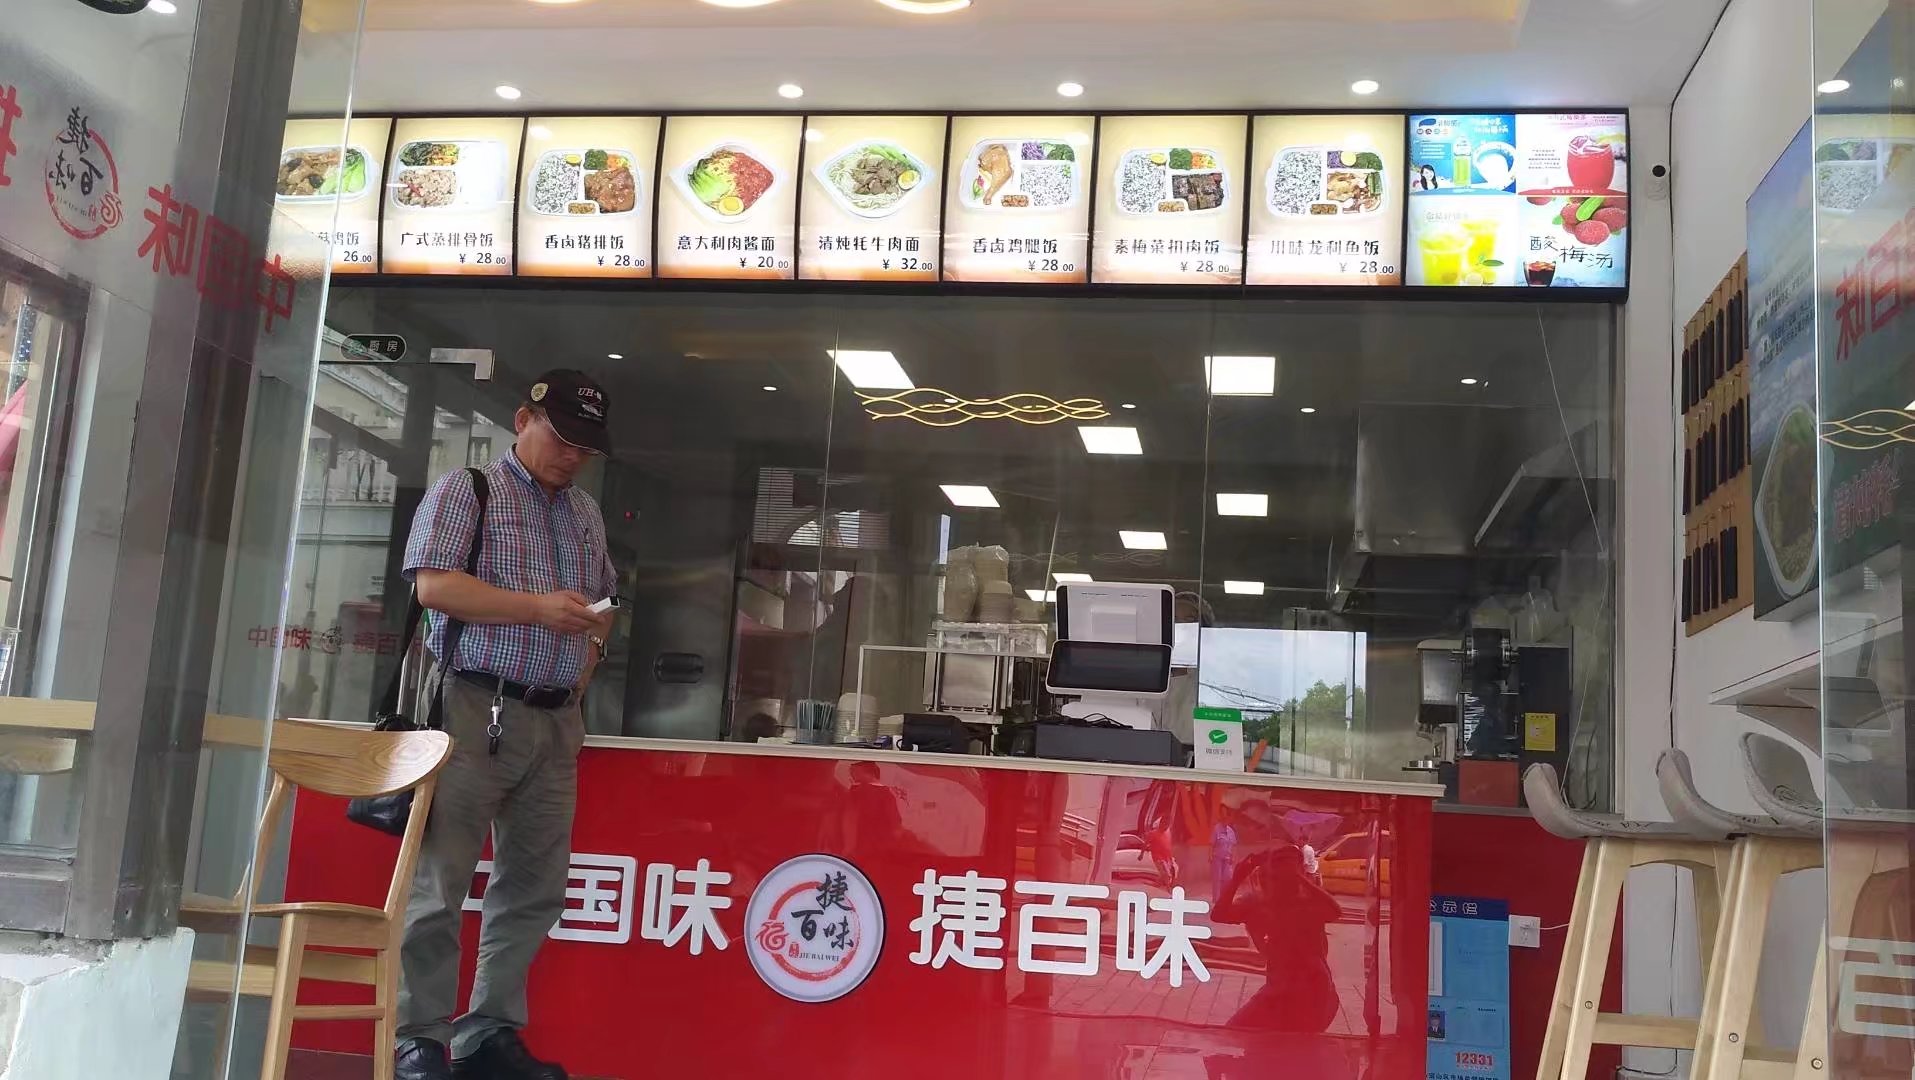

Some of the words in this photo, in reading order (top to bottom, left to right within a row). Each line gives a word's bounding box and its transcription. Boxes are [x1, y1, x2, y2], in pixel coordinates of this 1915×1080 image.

[401, 232, 494, 247] 广式蒸排骨饭
[545, 234, 624, 250] 香卤猪排饭
[678, 235, 775, 251] 意大利肉酱面
[819, 236, 920, 251] 清炖牦牛肉面
[973, 237, 1058, 253] 香卤鸡腿饭
[1270, 240, 1379, 255] 川味龙利鱼饭
[1530, 235, 1613, 269] 酸梅汤
[815, 871, 856, 912] 捷
[790, 909, 855, 951] 百味
[908, 868, 1212, 988] 捷百味
